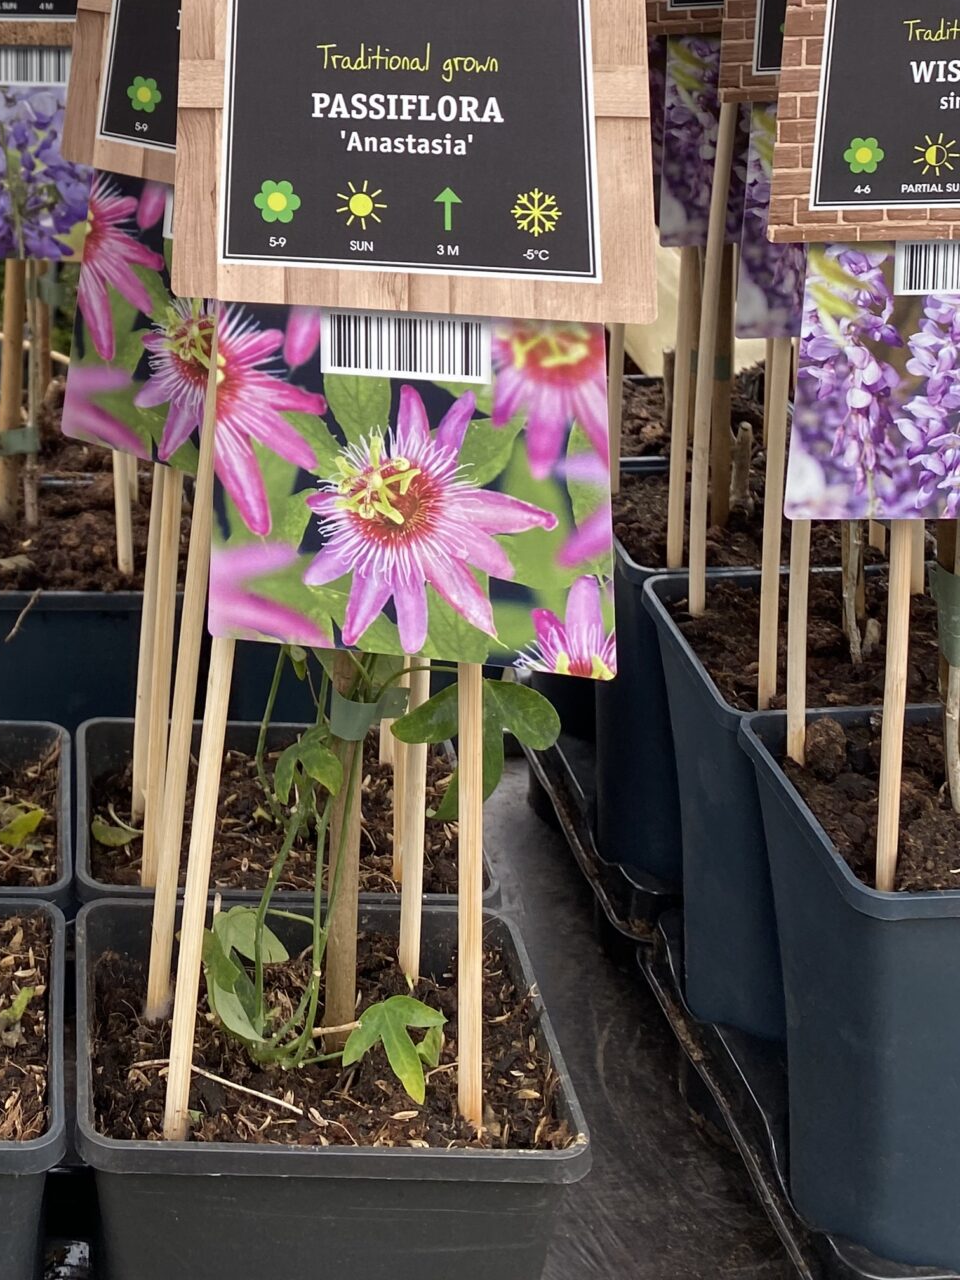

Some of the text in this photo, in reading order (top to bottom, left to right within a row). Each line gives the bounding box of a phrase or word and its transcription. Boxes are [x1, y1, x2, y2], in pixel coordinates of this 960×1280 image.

[317, 42, 499, 83] Traditional grown
[909, 60, 960, 84] WIS
[311, 91, 505, 124] PASSIFLORA
[134, 121, 149, 133] 5-9
[340, 130, 474, 157] 'Anastasia'
[853, 184, 872, 195] 4-6
[901, 183, 944, 194] PARTIAL
[269, 236, 287, 249] 5-9
[349, 239, 374, 252] SUN
[436, 244, 460, 257] 3 M
[522, 249, 550, 262] -5°C
